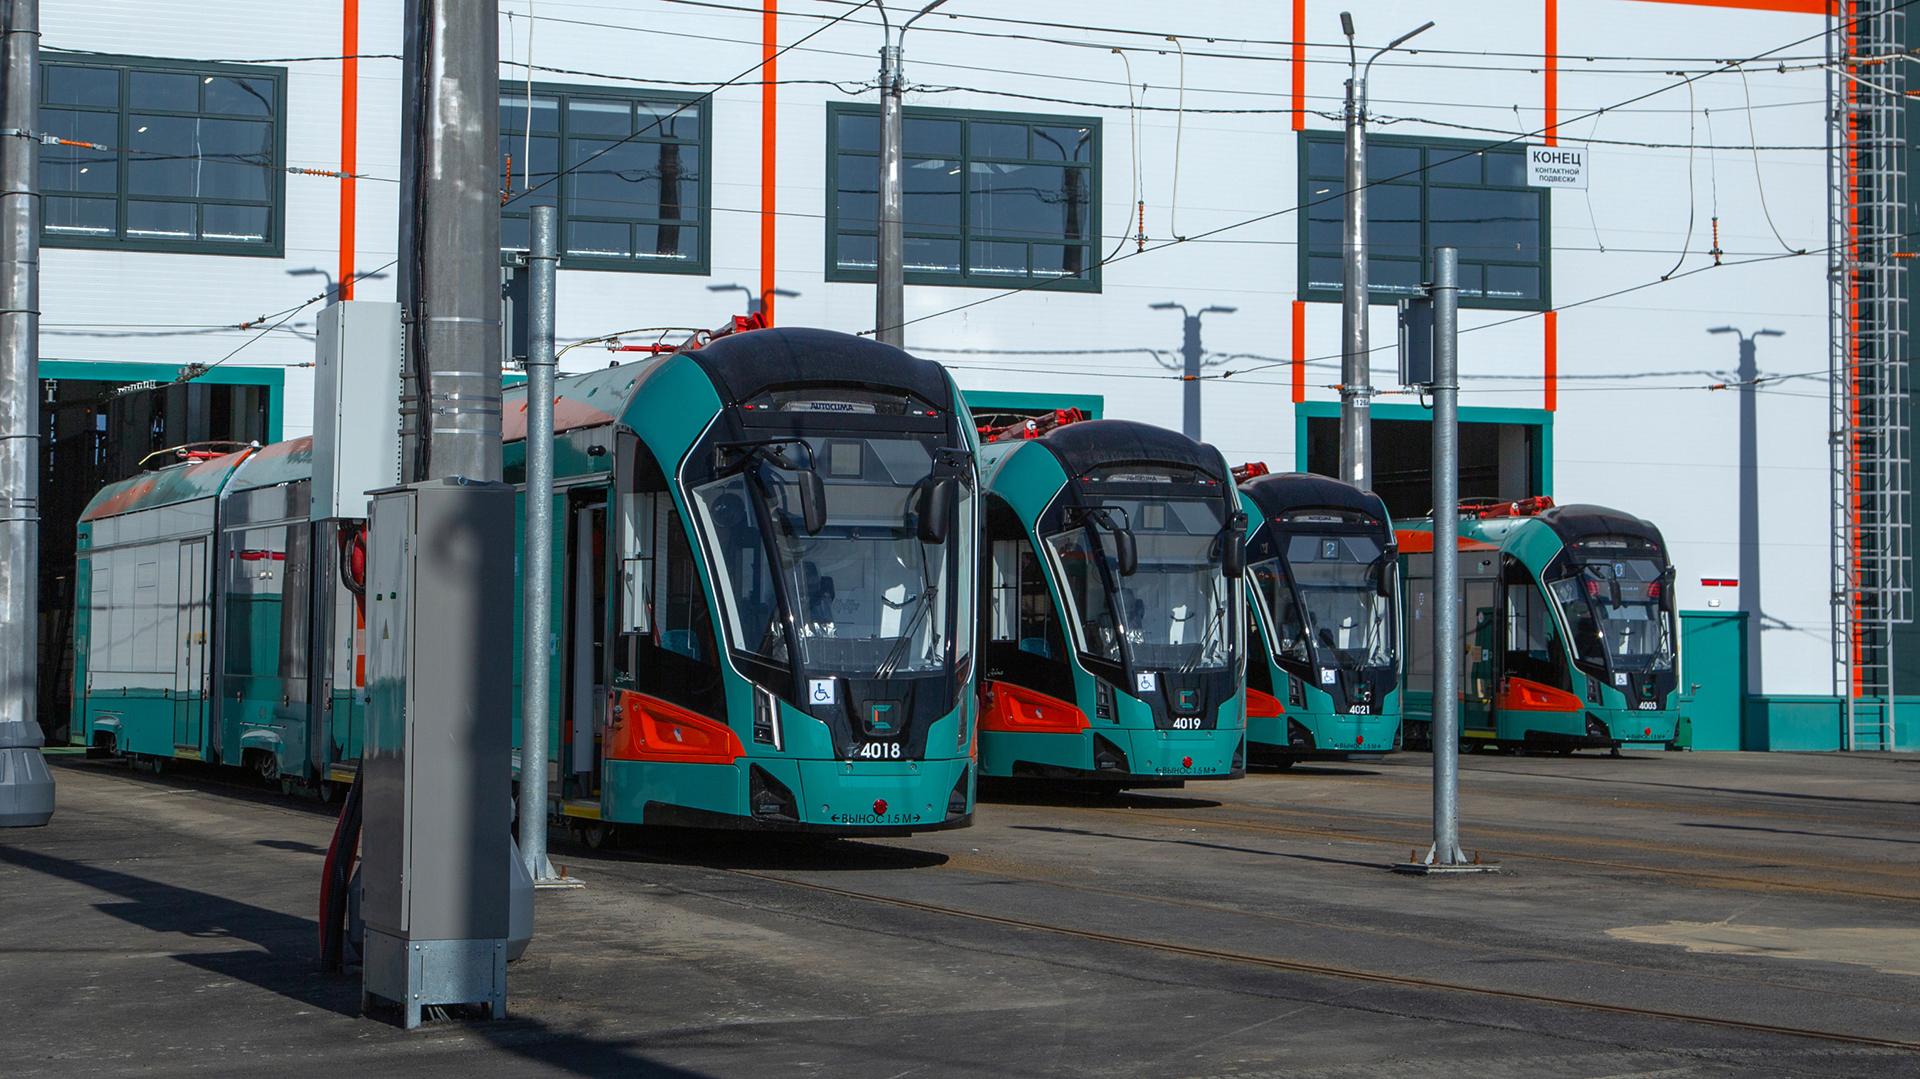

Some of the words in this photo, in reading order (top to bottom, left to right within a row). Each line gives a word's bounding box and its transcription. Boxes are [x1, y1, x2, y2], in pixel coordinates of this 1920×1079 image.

[1533, 151, 1581, 166] КОНЕЦ
[1535, 167, 1580, 175] КОНТАКТНОЙ
[1539, 174, 1576, 183] ПОДВЕСКИ
[1349, 704, 1370, 714] 4021
[1638, 701, 1657, 710] 4003
[1173, 717, 1201, 729] 4019
[860, 742, 901, 759] 4018
[841, 813, 885, 824] ВЫНОС
[887, 813, 900, 823] 1.5
